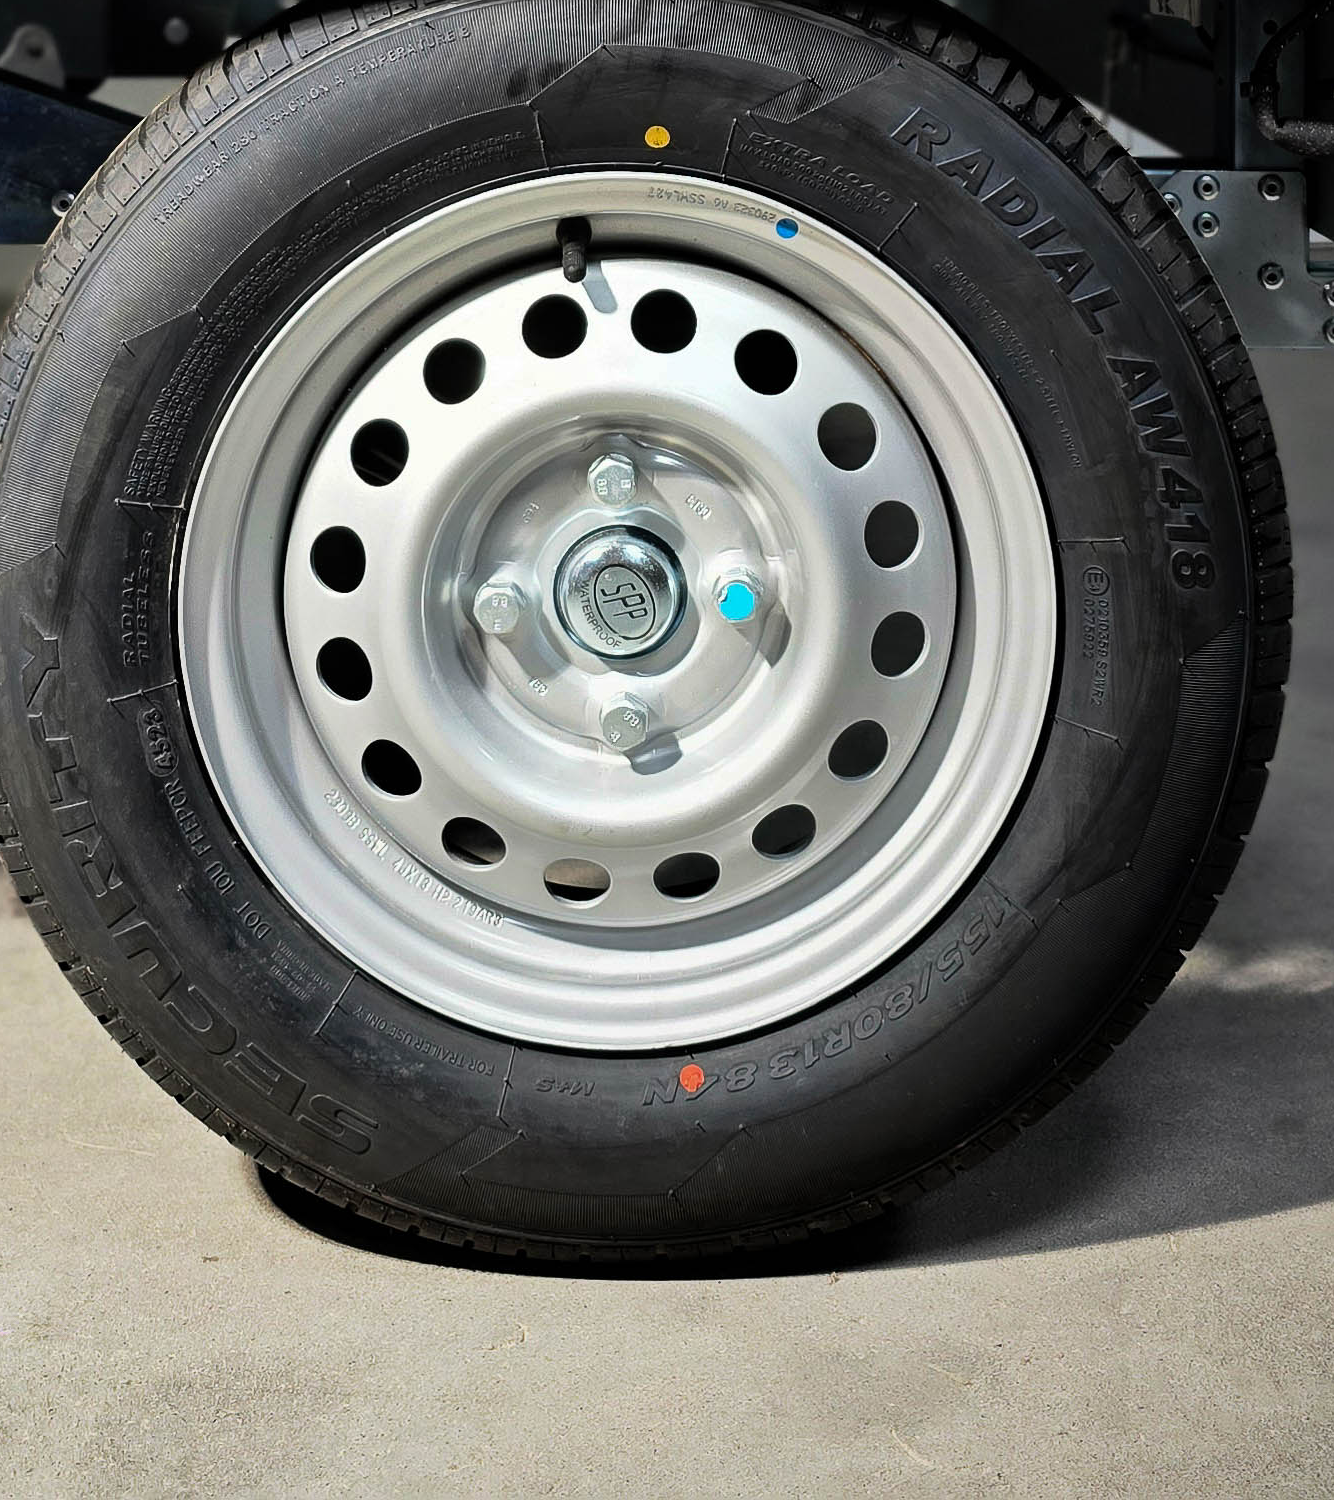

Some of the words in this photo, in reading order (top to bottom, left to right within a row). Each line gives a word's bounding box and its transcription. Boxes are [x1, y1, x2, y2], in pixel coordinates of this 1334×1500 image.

[890, 106, 1120, 336] RADIAL
[1104, 353, 1215, 591] AW418
[577, 580, 622, 649] WATERPROOF
[600, 583, 648, 621] SPP
[22, 630, 381, 1157] SECURITY
[231, 896, 273, 942] DOT
[762, 894, 1011, 1084] 155/80R13
[385, 1022, 415, 1047] USE
[411, 1034, 467, 1070] TRAILER
[466, 1055, 495, 1078] FOR
